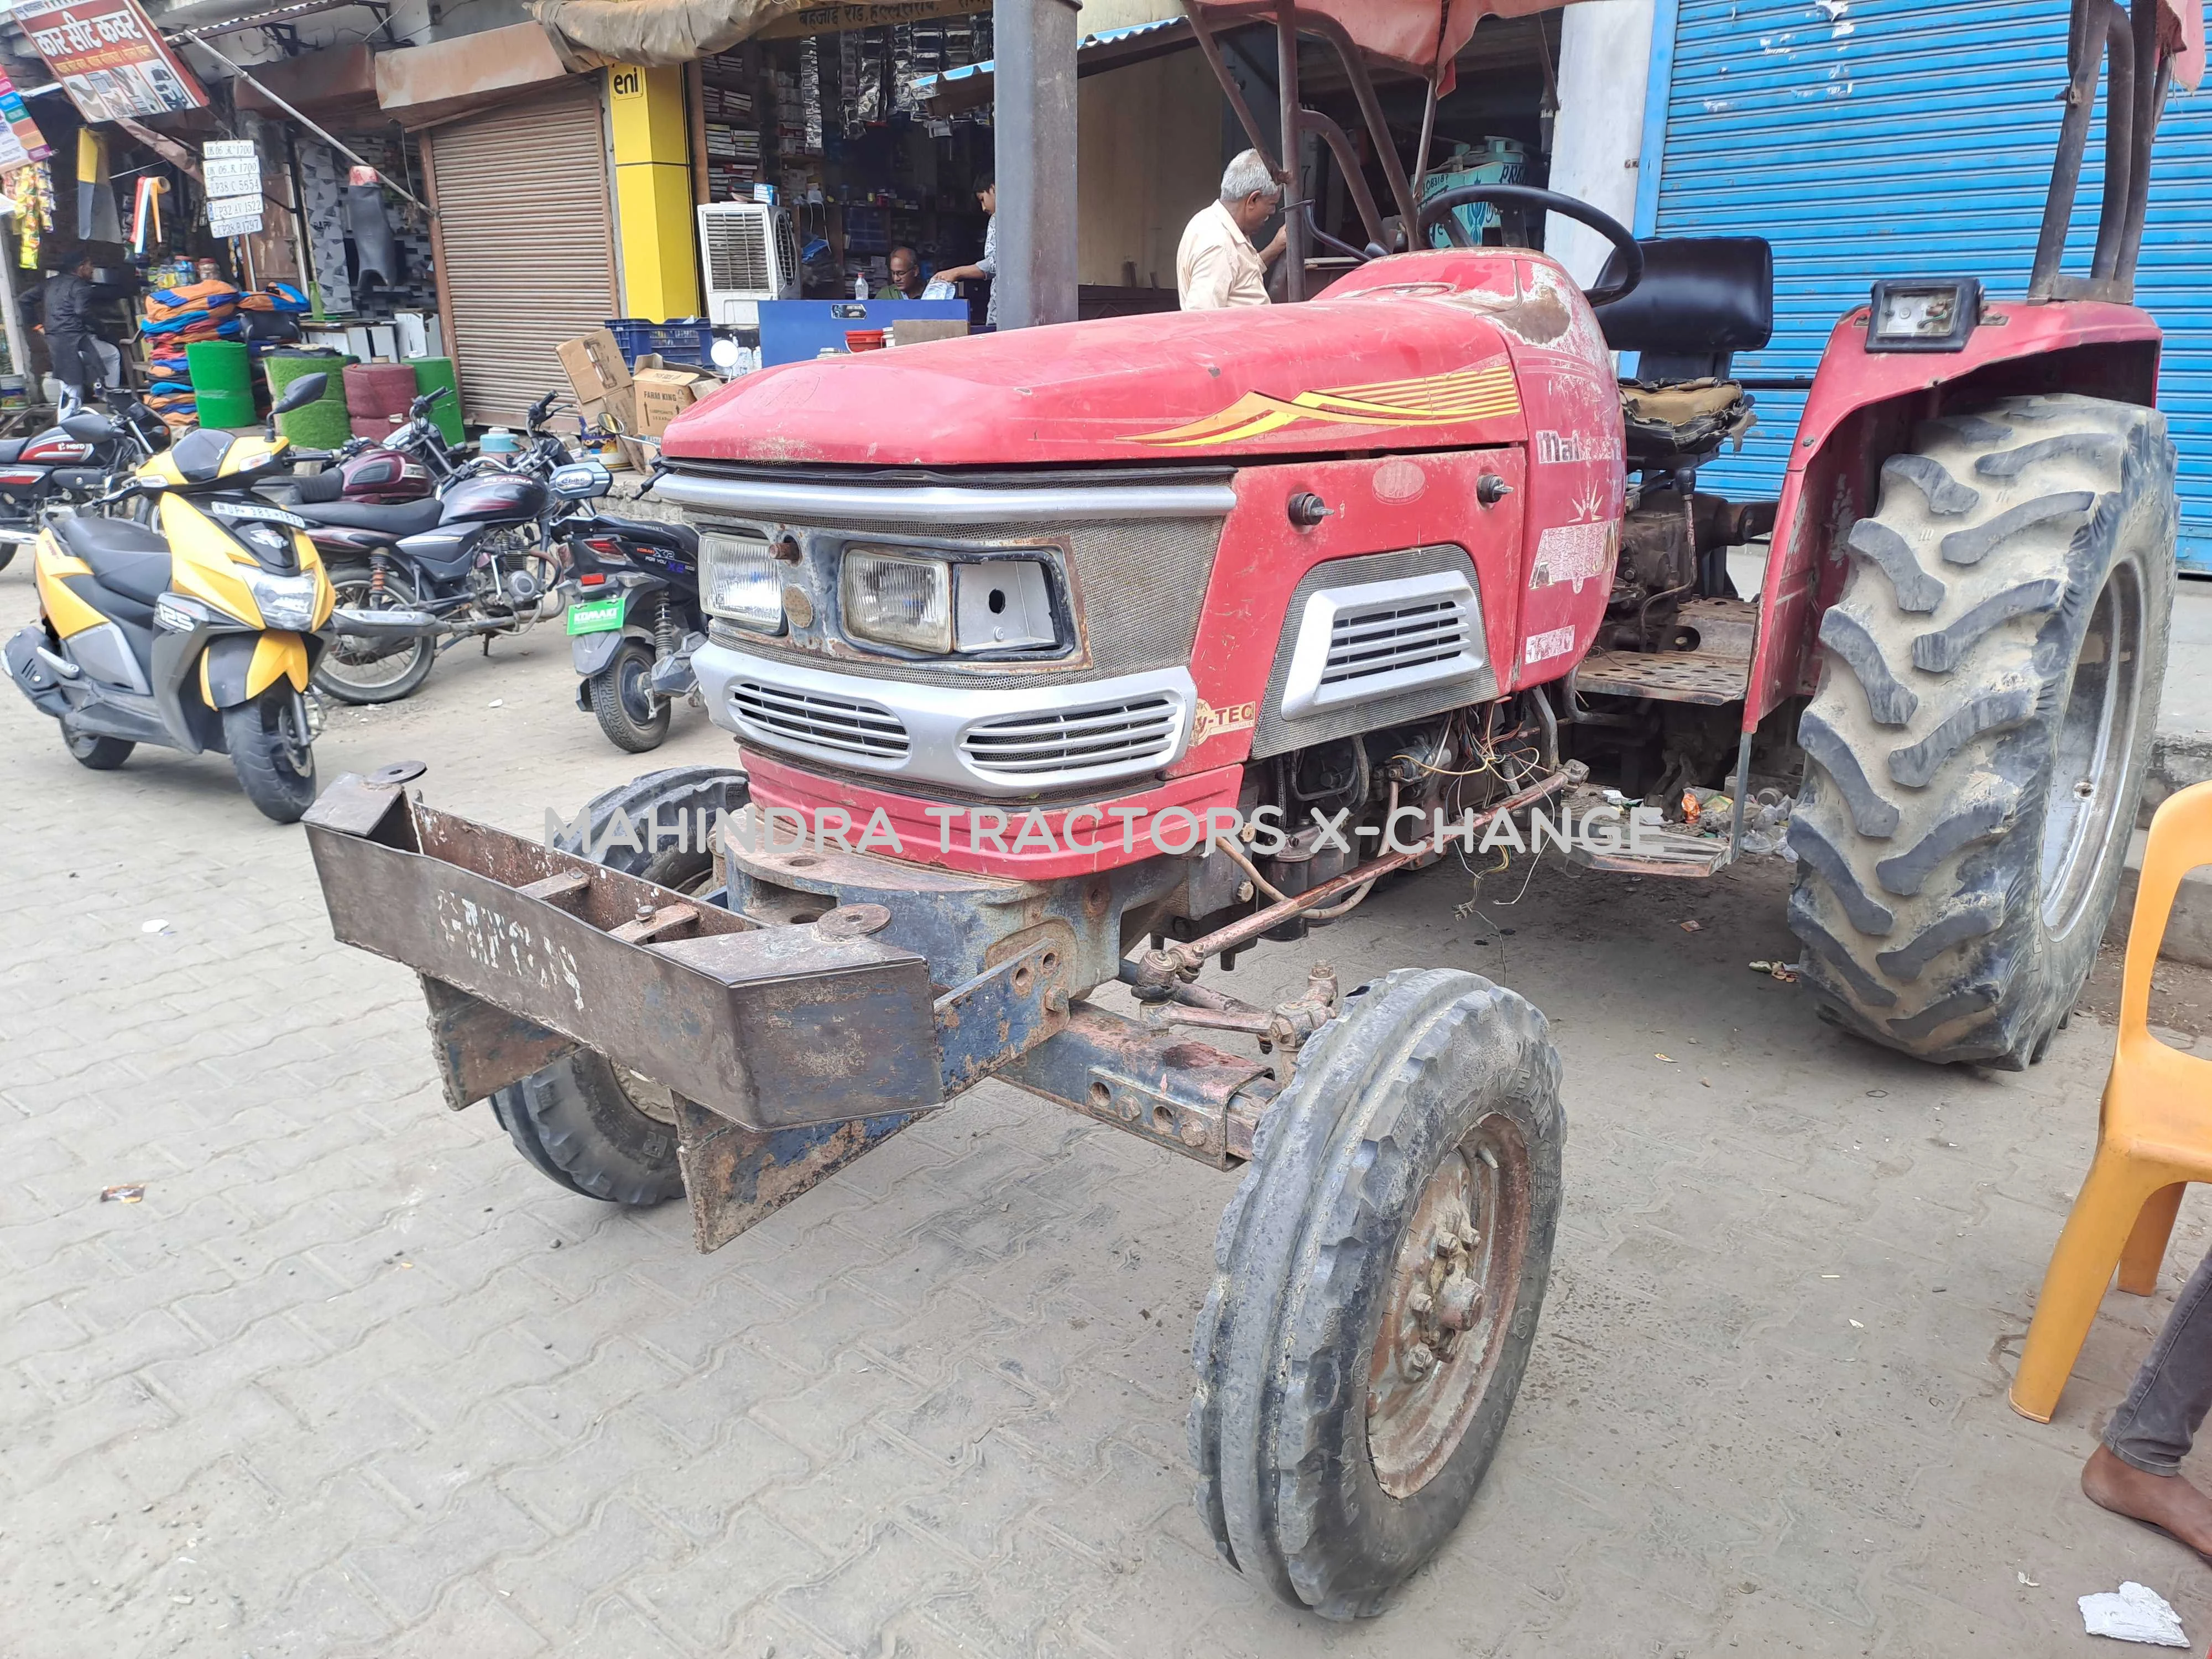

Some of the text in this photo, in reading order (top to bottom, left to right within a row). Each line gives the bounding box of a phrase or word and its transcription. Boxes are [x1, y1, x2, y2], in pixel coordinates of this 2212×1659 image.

[32, 9, 143, 56] कार सीट कवर
[613, 66, 639, 95] eni
[644, 390, 677, 401] FARM KING
[483, 477, 533, 486] PLATINA
[158, 603, 195, 632] 125
[573, 607, 618, 623] KOMAKI
